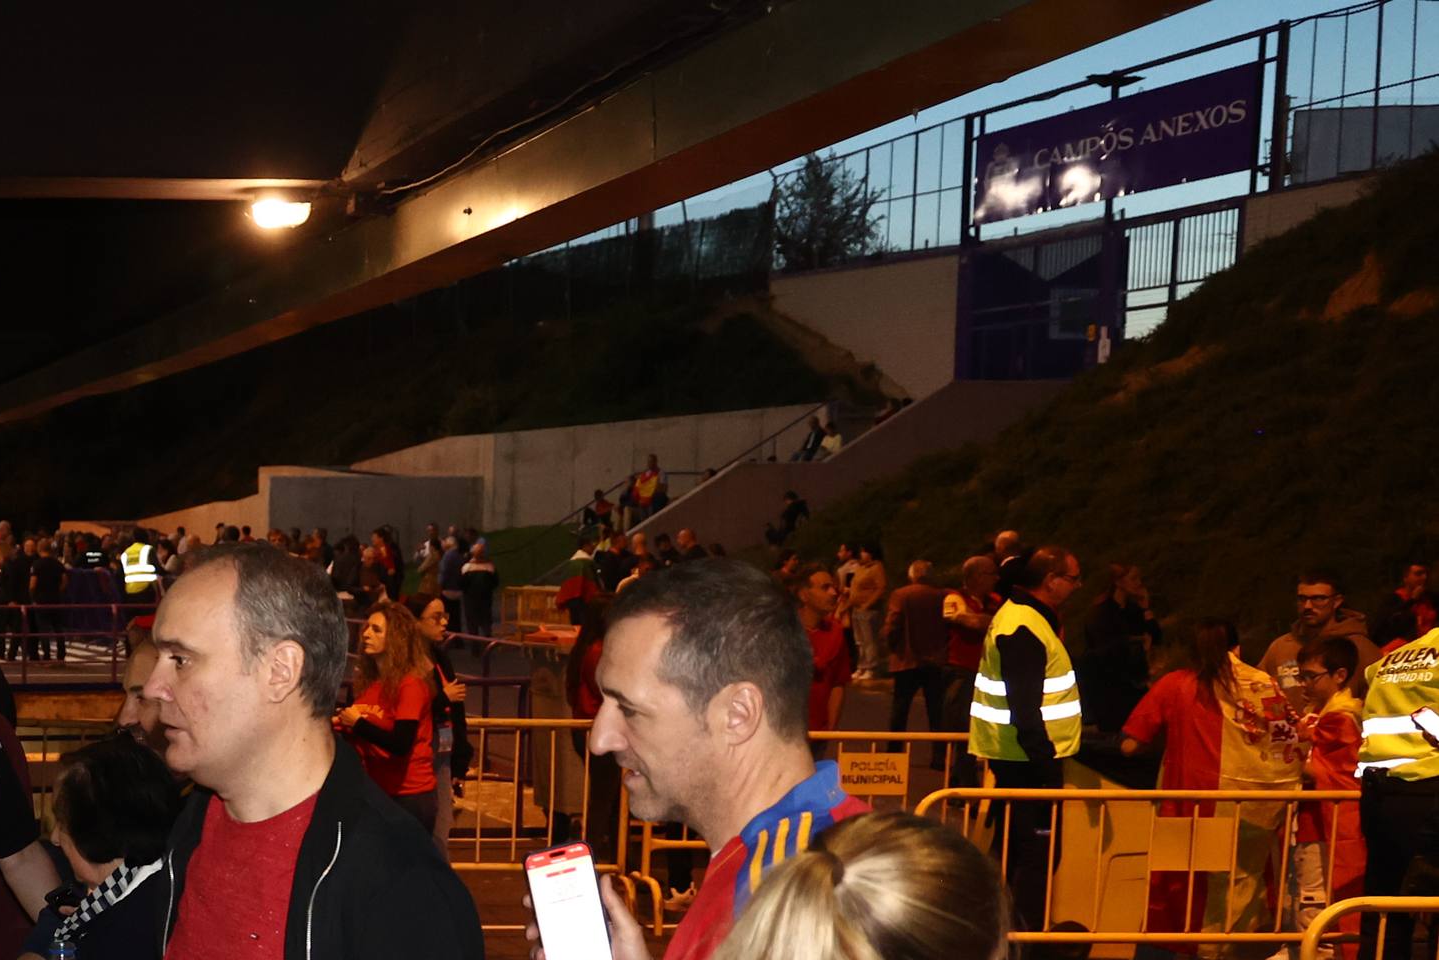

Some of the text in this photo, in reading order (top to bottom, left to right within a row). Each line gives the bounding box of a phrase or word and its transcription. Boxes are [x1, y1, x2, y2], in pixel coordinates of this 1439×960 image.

[1033, 99, 1248, 170] CAMPOS ANEXOS
[841, 774, 904, 785] MUNICIPAL
